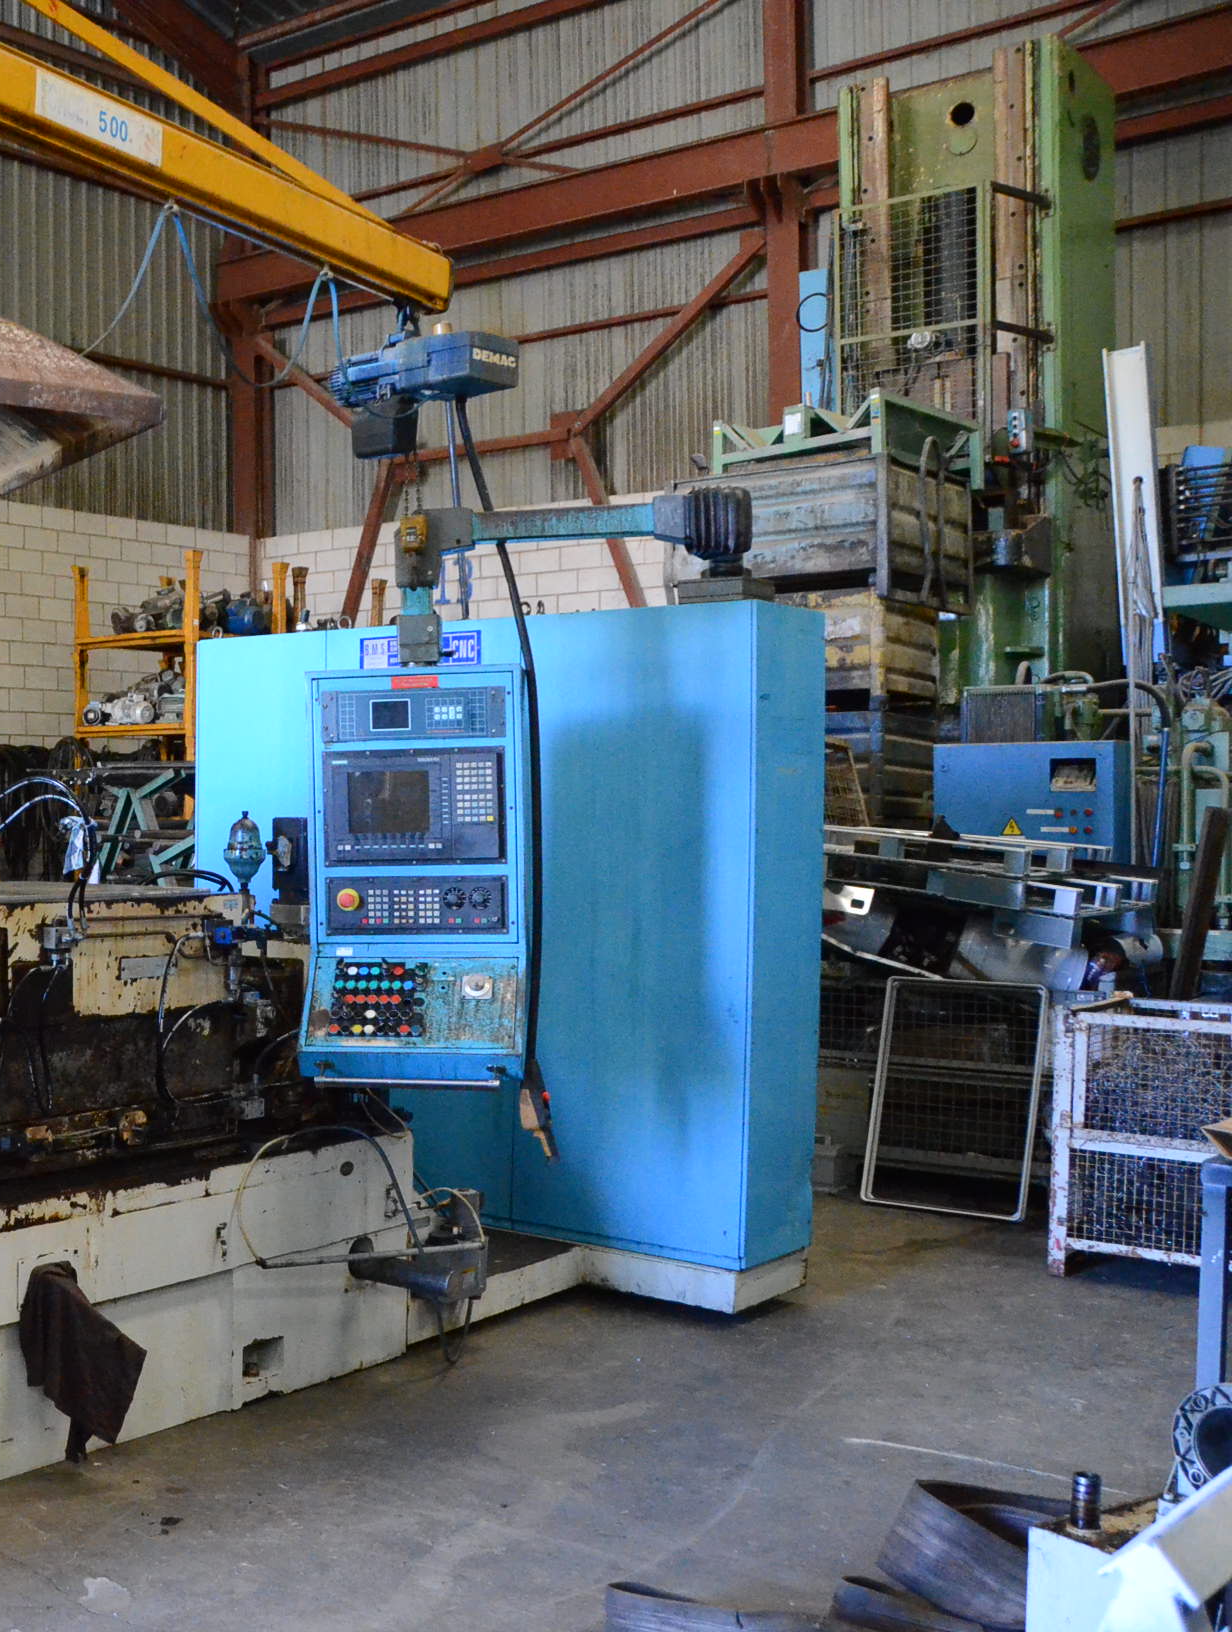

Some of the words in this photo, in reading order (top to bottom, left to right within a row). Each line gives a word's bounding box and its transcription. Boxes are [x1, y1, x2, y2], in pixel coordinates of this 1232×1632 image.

[99, 110, 128, 142] 500
[472, 347, 516, 368] DEMAG
[452, 638, 474, 659] CNC
